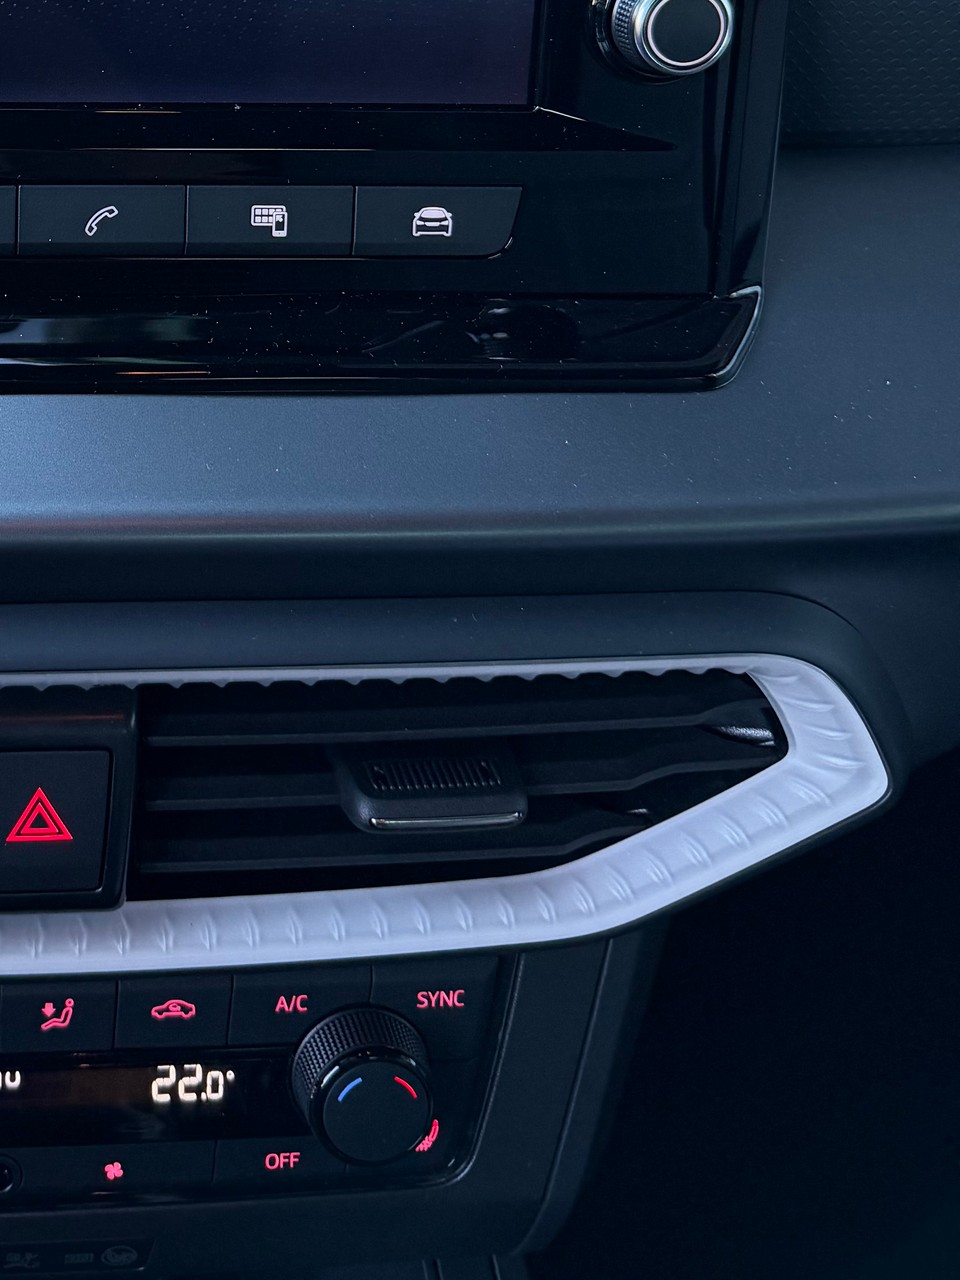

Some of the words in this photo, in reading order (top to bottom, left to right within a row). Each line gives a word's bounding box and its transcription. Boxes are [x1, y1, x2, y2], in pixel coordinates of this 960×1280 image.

[274, 994, 308, 1013] A/C
[417, 989, 465, 1008] SYNC
[265, 1152, 301, 1170] OFF
